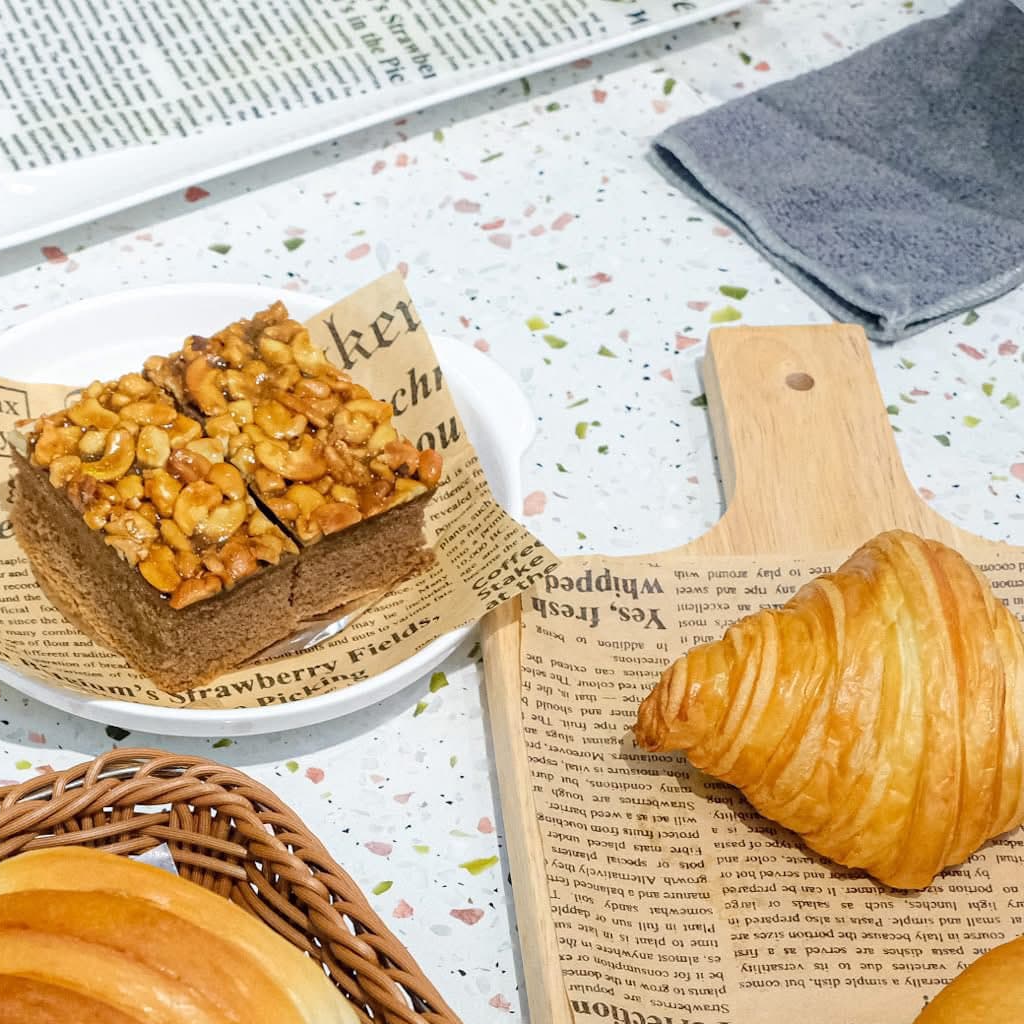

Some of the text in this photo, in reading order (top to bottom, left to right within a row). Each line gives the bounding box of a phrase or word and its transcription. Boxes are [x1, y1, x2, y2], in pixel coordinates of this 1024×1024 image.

[708, 571, 747, 581] around
[757, 568, 781, 580] play
[545, 564, 664, 600] whipped
[530, 596, 667, 630] Yes, fresh
[678, 603, 730, 613] excellent
[598, 640, 644, 651] addition
[166, 660, 339, 708] Strawberry
[345, 616, 440, 663] Fields,
[536, 700, 572, 715] should
[546, 730, 574, 742] slugs
[545, 744, 604, 761] Moreover,
[552, 788, 583, 801] tough
[579, 864, 655, 885] Alternatively
[604, 900, 638, 912] sandy
[745, 913, 800, 926] prepared
[862, 932, 911, 942] because
[916, 931, 943, 942] Italy
